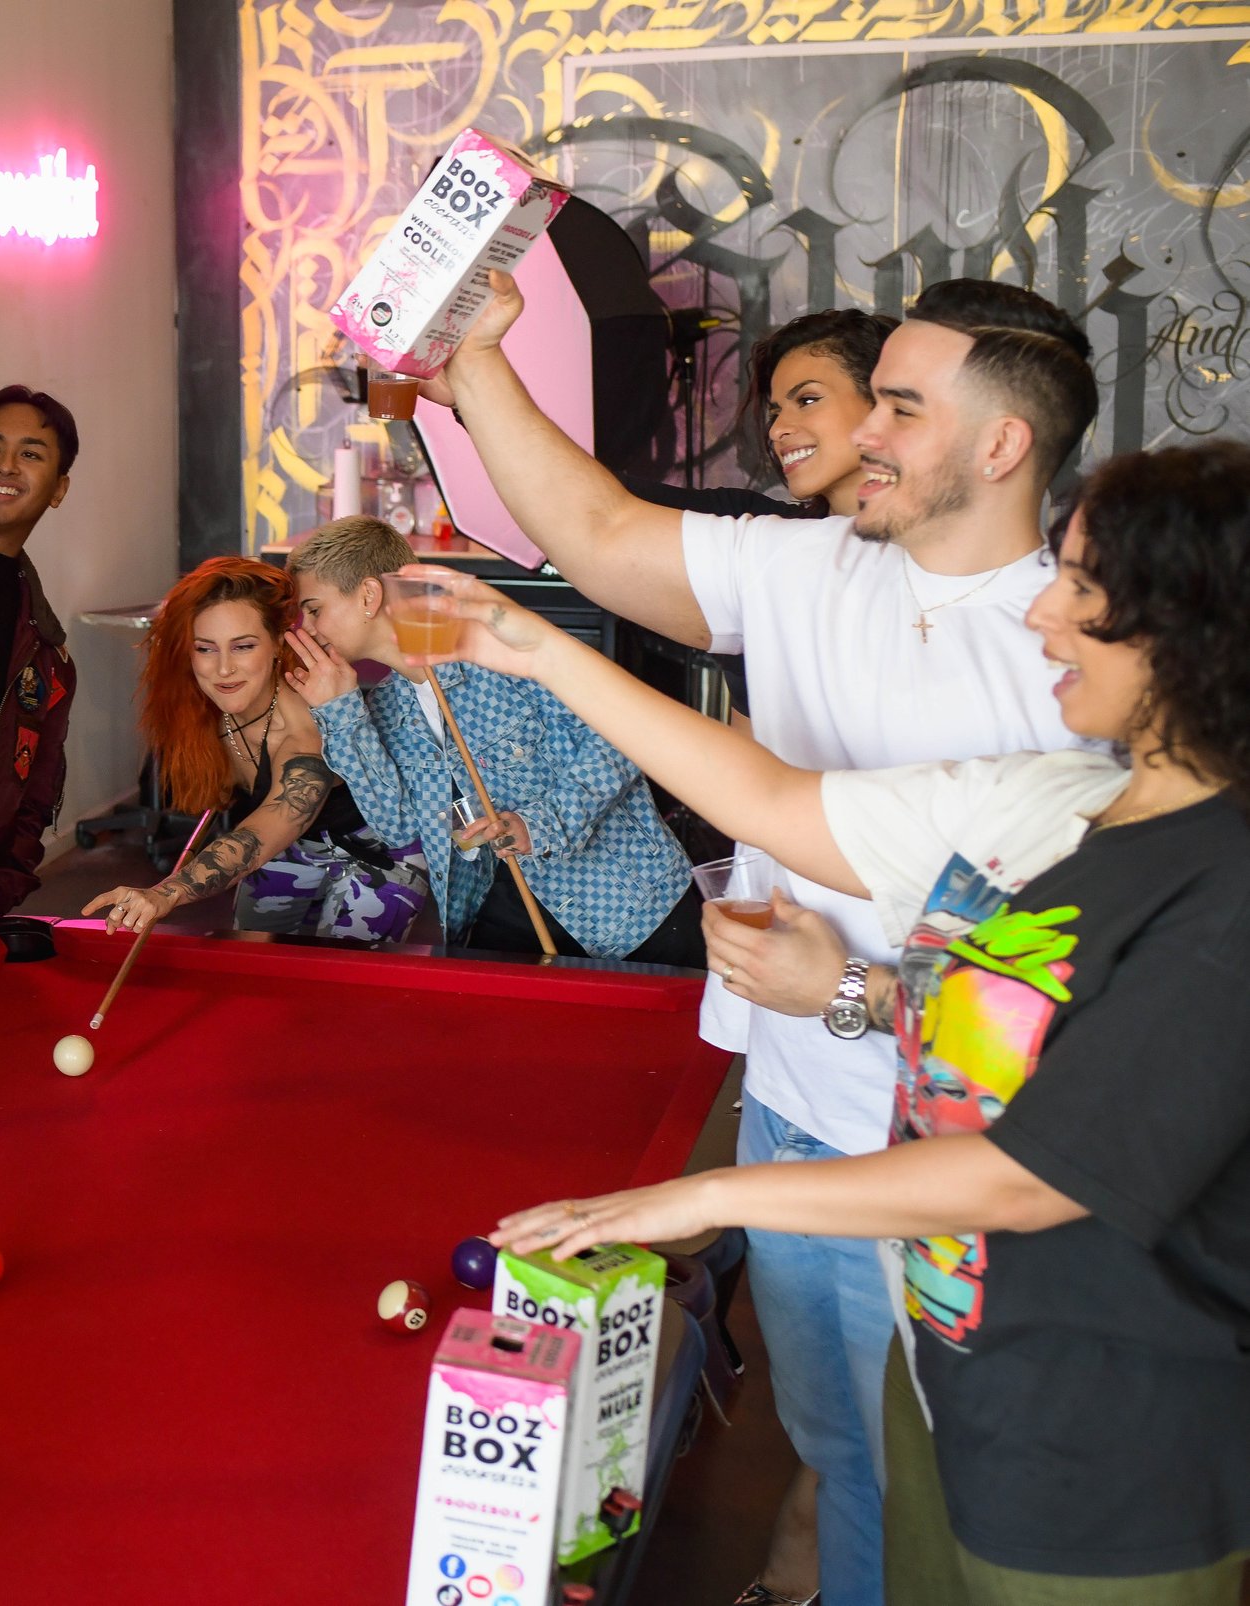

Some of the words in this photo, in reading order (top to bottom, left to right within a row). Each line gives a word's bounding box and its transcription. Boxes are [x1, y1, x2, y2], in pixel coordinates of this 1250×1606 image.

[431, 174, 491, 229] BOX
[447, 158, 505, 209] BOOZ
[423, 198, 477, 240] COCKTAILS
[403, 226, 456, 270] COOLER
[410, 1311, 424, 1326] 15
[599, 1296, 654, 1336] BOOZ
[596, 1320, 651, 1366] BOX
[446, 1405, 542, 1440] BOOZ
[597, 1390, 642, 1423] MULE
[443, 1430, 537, 1473] BOX
